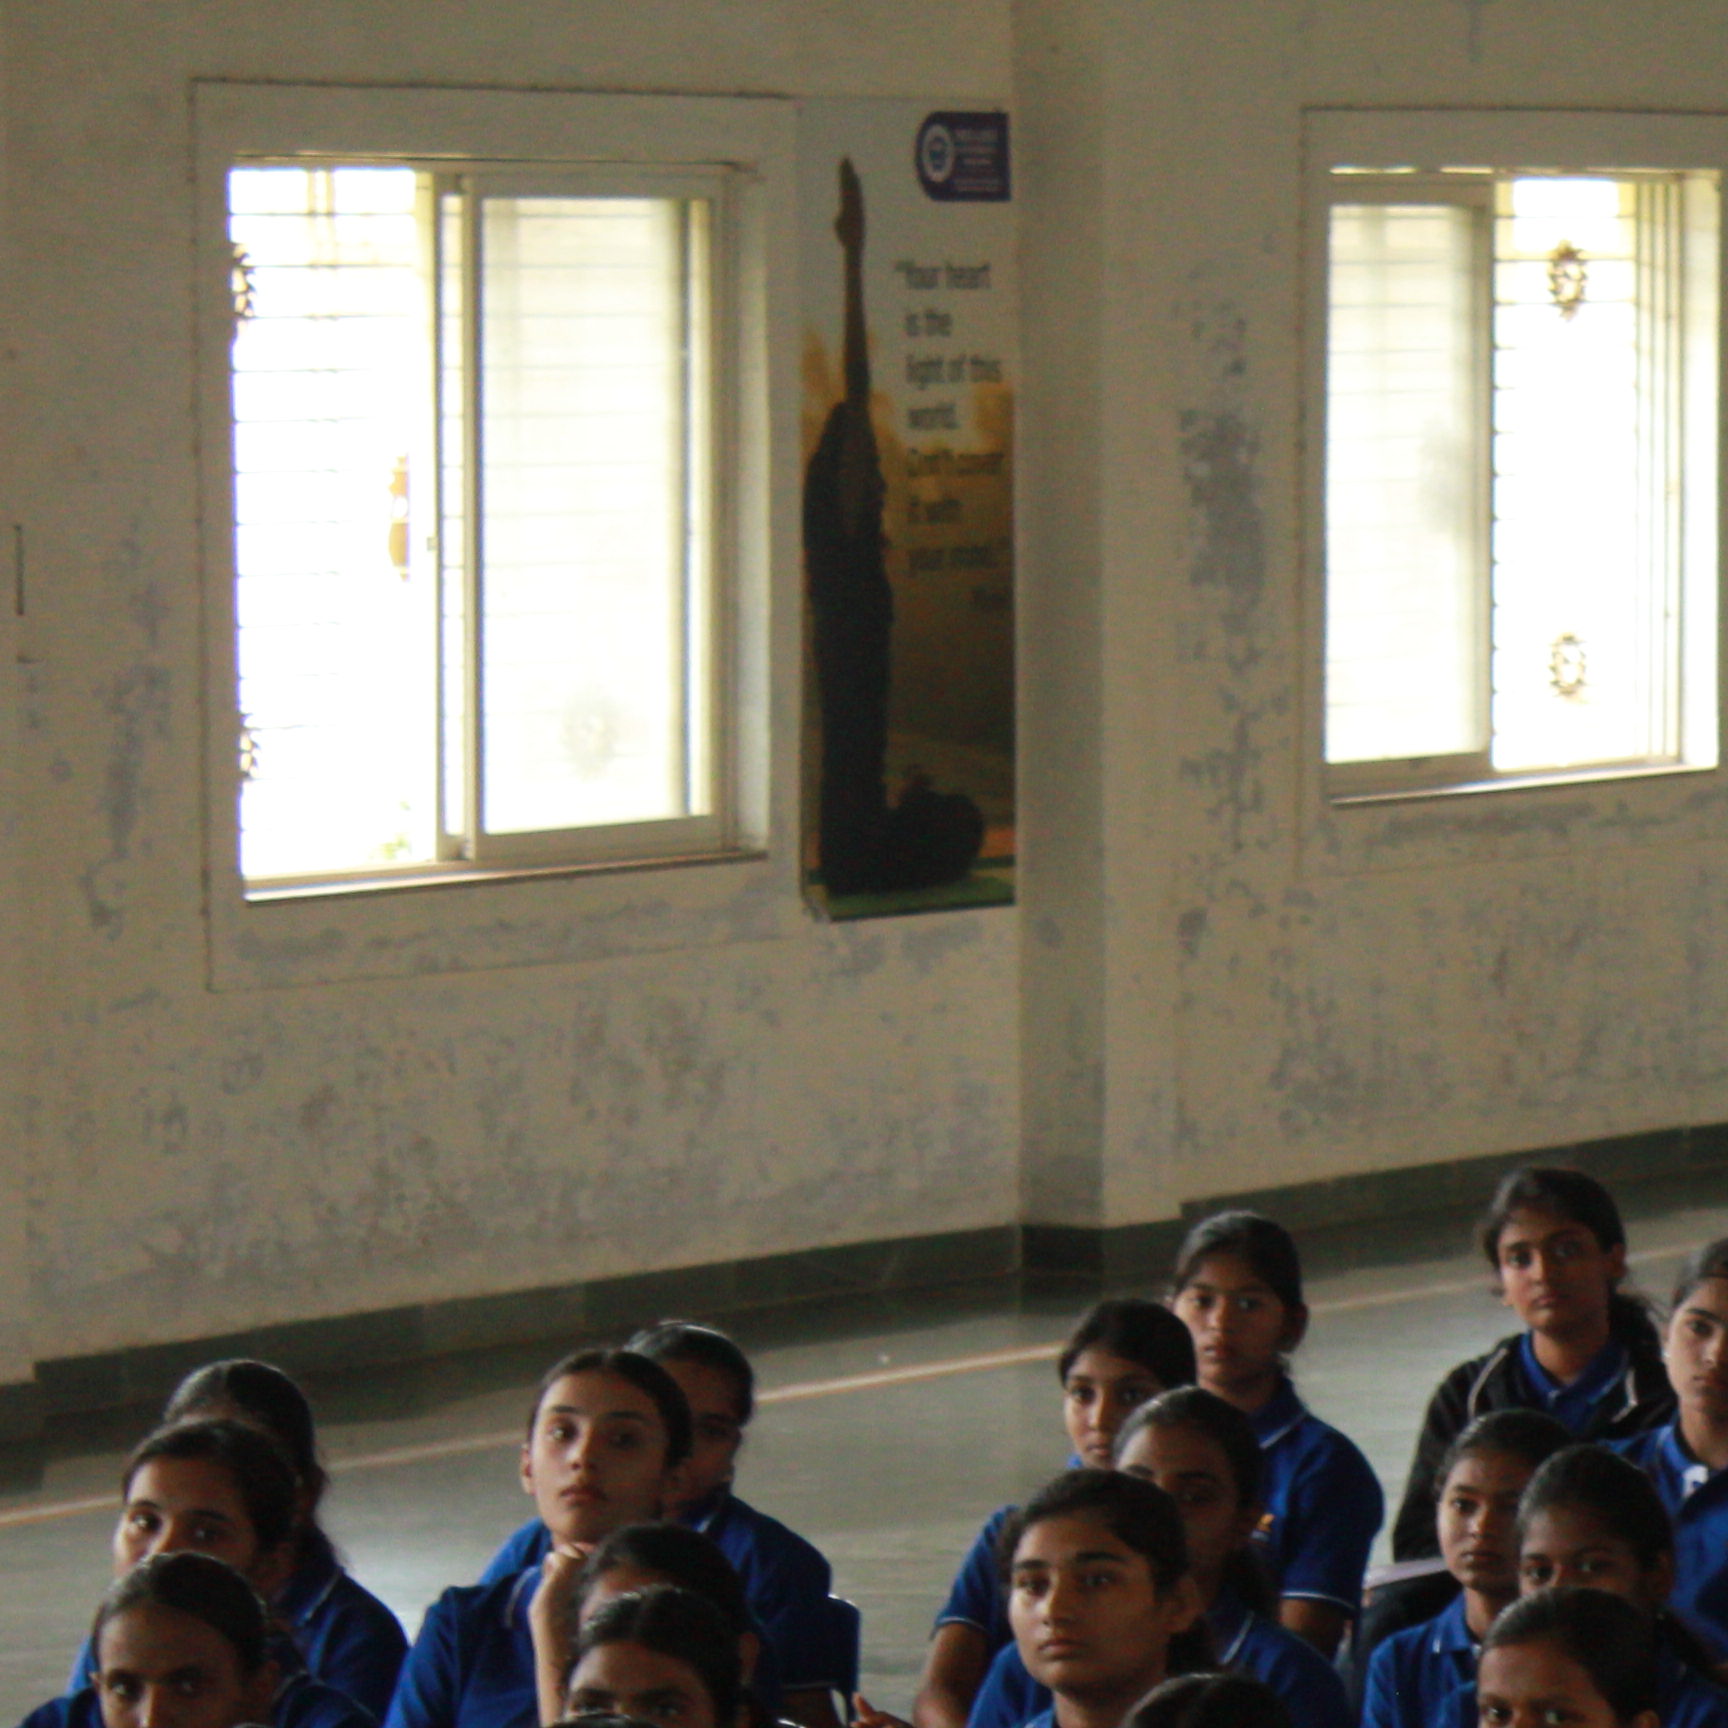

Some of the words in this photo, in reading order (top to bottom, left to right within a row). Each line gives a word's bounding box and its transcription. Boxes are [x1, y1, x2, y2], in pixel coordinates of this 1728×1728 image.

[947, 259, 991, 290] heart
[925, 308, 953, 337] the
[906, 353, 943, 390] light
[949, 353, 966, 384] of
[970, 354, 1002, 384] this
